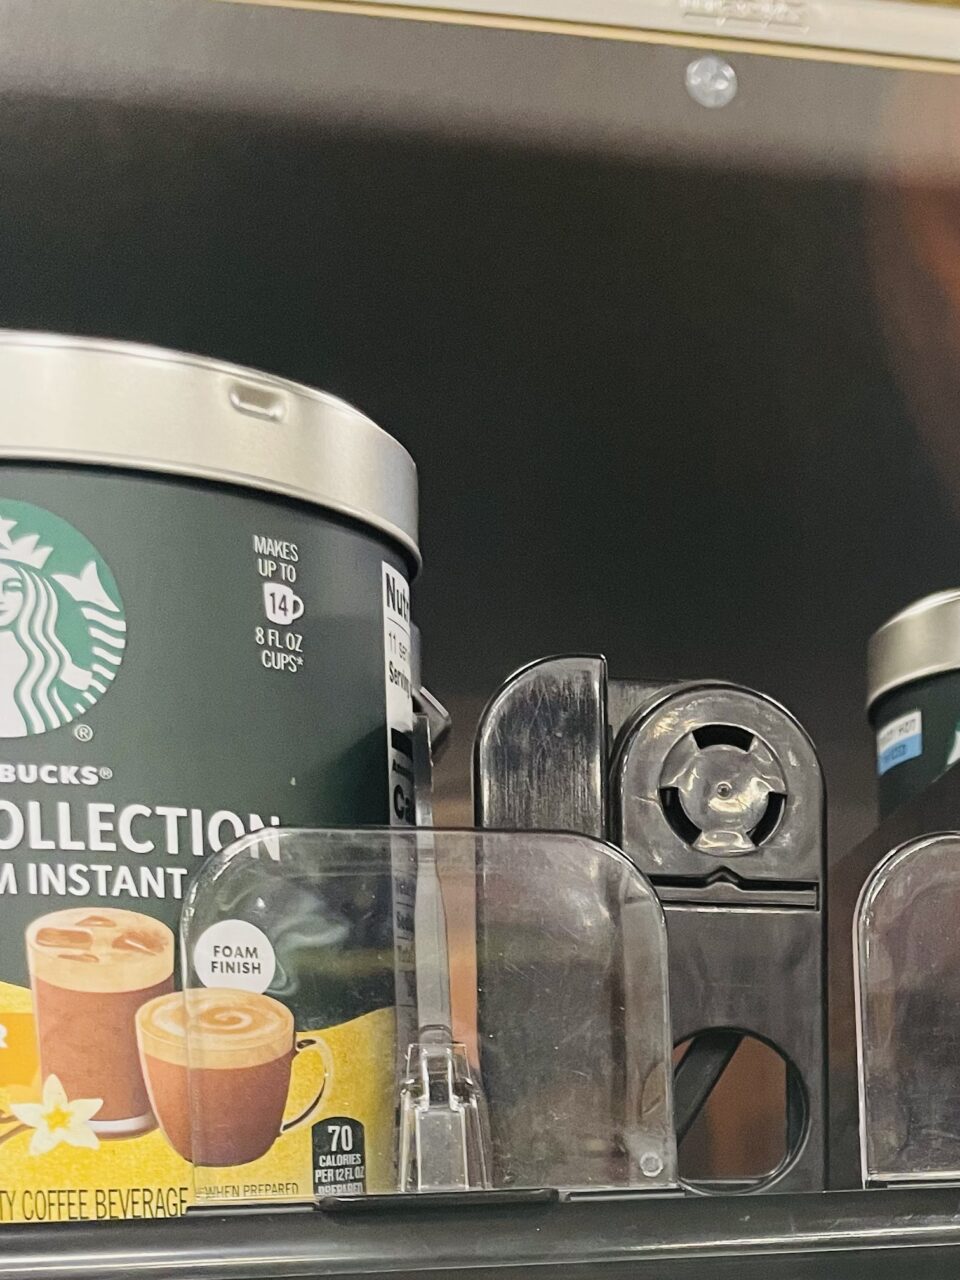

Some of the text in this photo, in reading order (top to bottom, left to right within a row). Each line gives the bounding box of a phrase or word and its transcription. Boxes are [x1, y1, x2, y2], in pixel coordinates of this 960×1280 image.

[253, 535, 298, 561] MAKES
[258, 559, 296, 582] UP TO
[270, 592, 288, 616] 14
[255, 627, 303, 652] 8 FL OZ
[0, 800, 281, 862] OLLECTION
[29, 863, 188, 899] INSTANT
[212, 945, 259, 960] FOAM
[210, 961, 262, 975] FINISH
[327, 1125, 353, 1152] 70
[319, 1153, 362, 1168] CALORIES
[315, 1169, 334, 1183] PER
[22, 1189, 90, 1221] COFFEE
[95, 1187, 189, 1220] BEVERAGE
